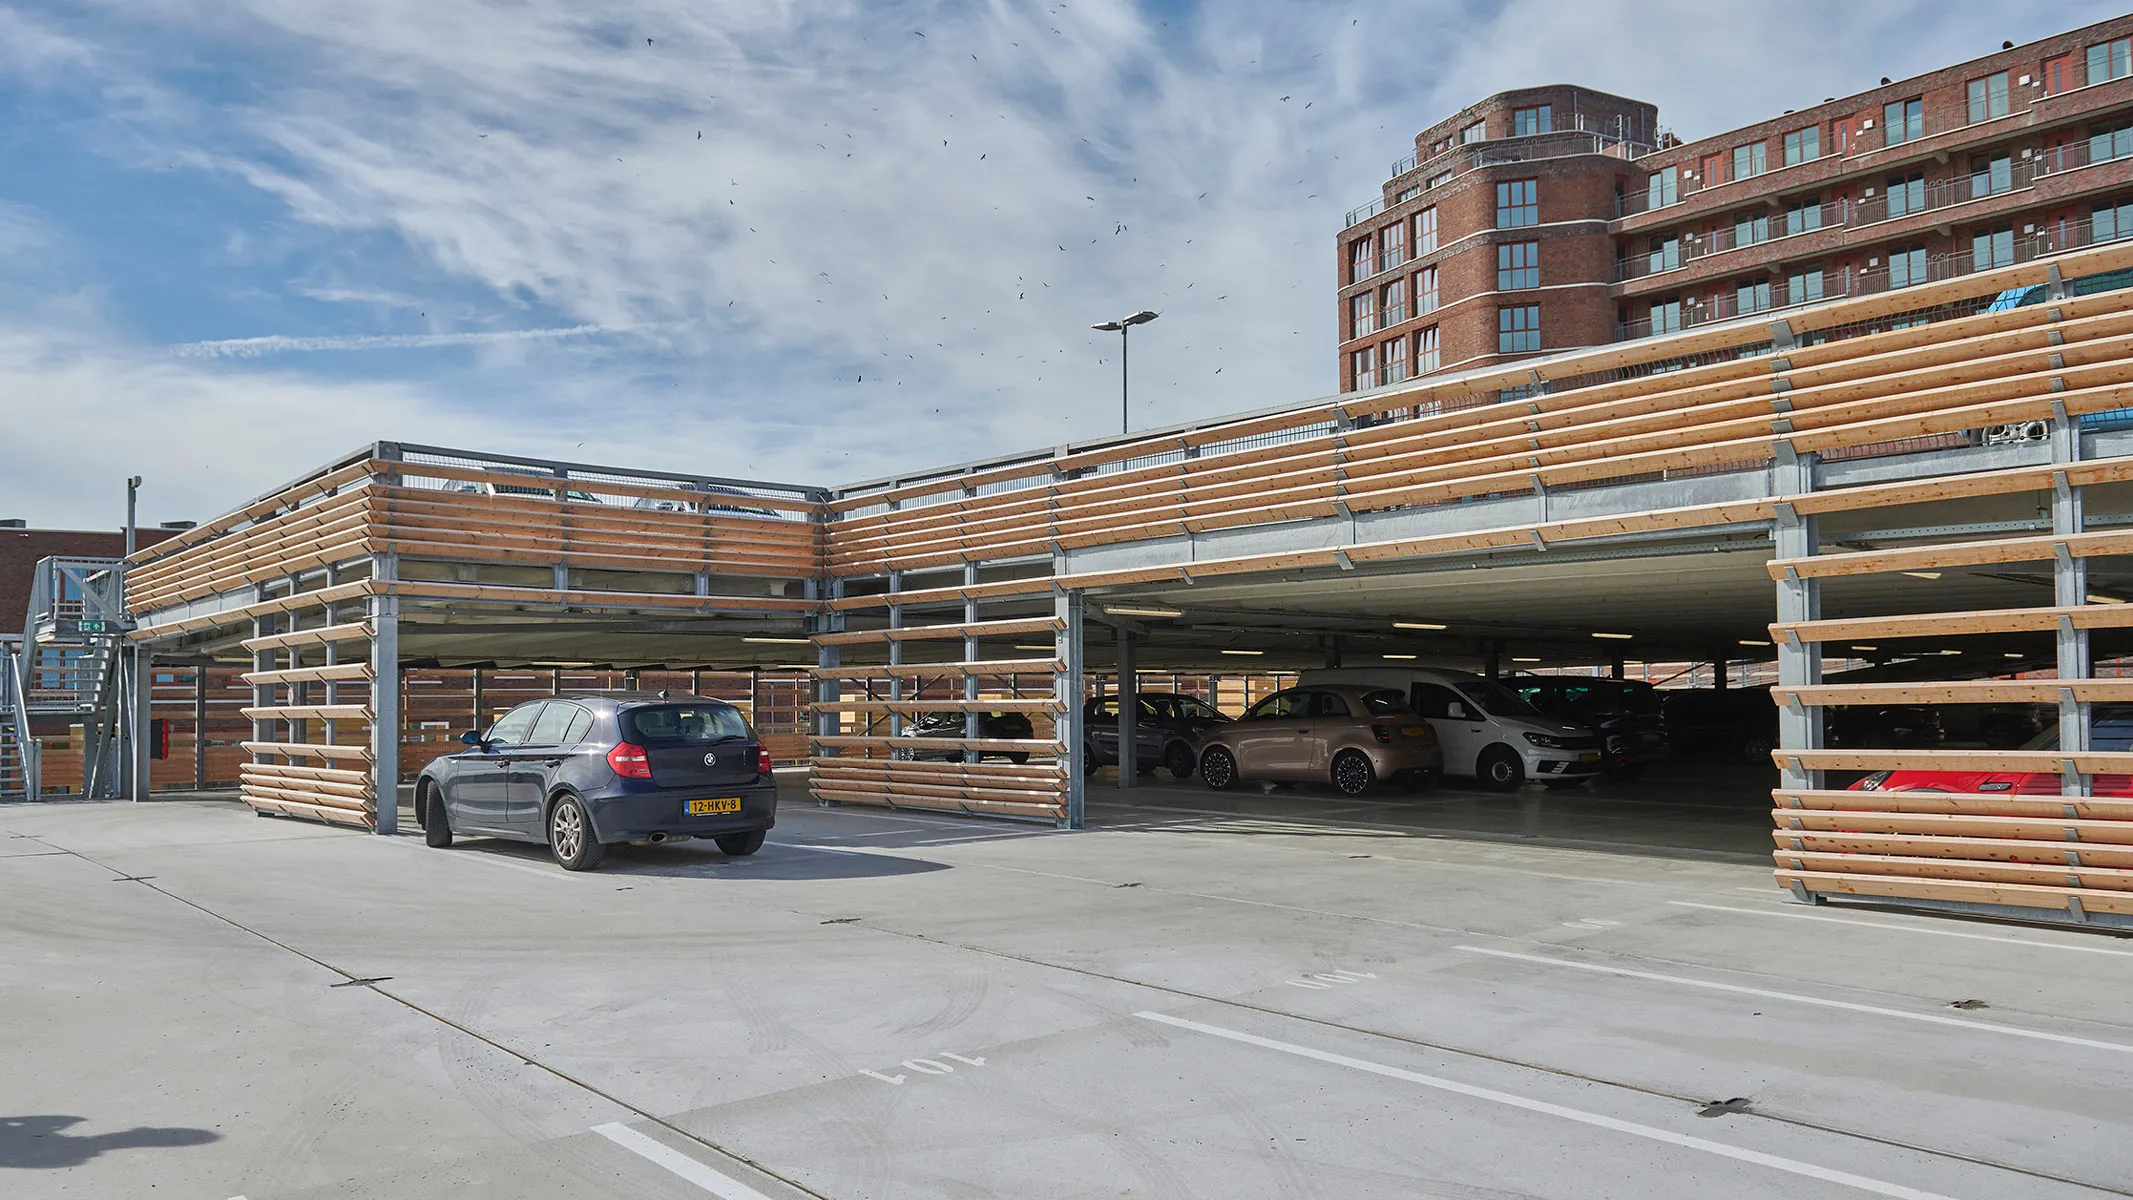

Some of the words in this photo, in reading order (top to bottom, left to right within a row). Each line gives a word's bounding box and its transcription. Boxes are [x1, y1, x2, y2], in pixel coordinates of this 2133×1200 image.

[693, 799, 737, 812] 12-HKV-8
[1285, 968, 1379, 990] 100
[858, 1052, 986, 1085] 101
